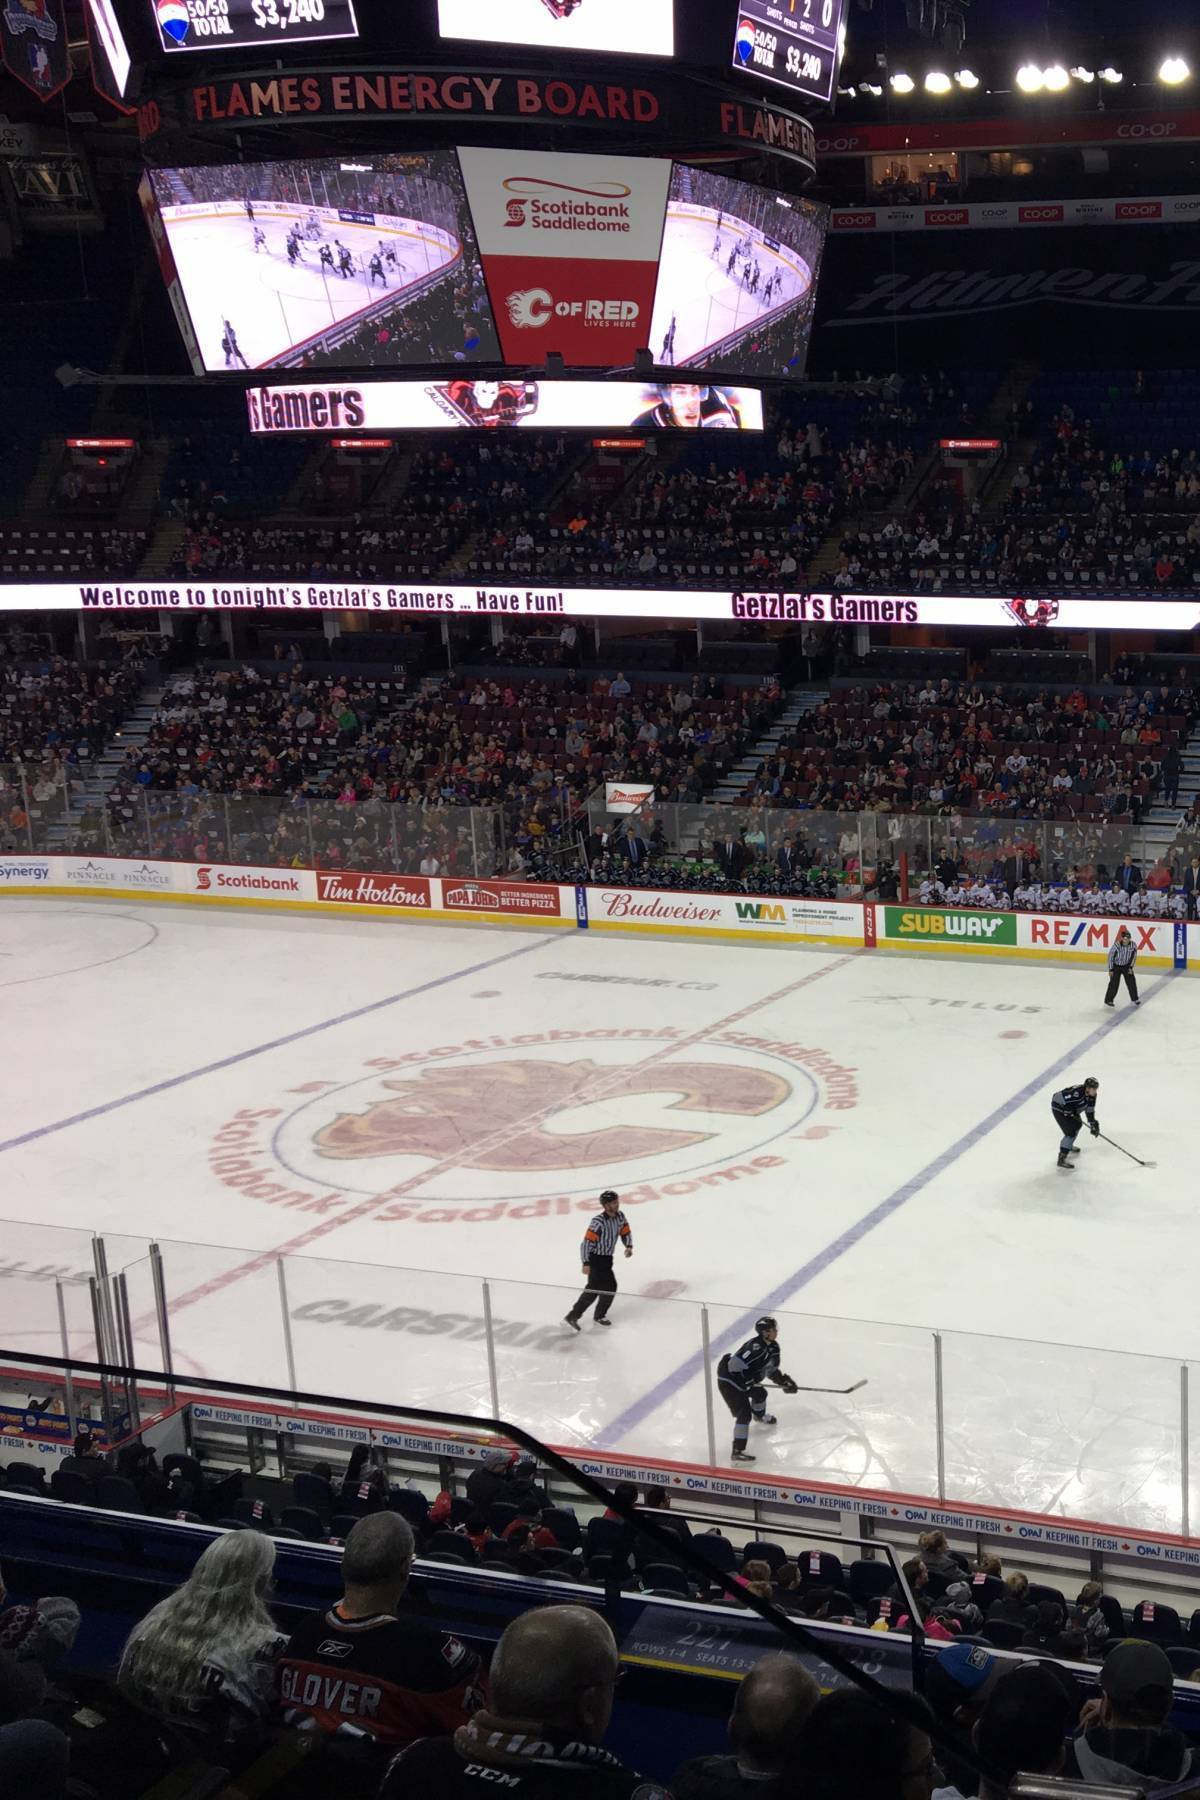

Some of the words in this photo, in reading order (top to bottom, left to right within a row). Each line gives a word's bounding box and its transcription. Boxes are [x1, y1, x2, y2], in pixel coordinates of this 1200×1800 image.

[190, 15, 234, 37] TOTAL
[753, 45, 775, 69] TOTAL
[754, 29, 778, 51] 50/50
[785, 45, 822, 81] $3,240
[192, 77, 321, 121] FLAMES
[331, 74, 503, 112] ENERGY
[516, 79, 660, 123] BOARD
[720, 102, 800, 151] FLAMES
[531, 199, 630, 218] Scotiabank
[531, 215, 631, 233] Saddledome
[555, 301, 583, 317] OF
[585, 300, 640, 321] RED
[260, 387, 366, 429] Gamers
[80, 587, 180, 606] Welcome
[186, 588, 206, 606] to
[213, 587, 302, 608] tonight's
[307, 587, 382, 608] Getzlaf's
[387, 589, 454, 609] Gamers
[477, 591, 520, 611] Have
[526, 592, 565, 612] Fun!
[731, 592, 824, 620] Getzlaf's
[830, 596, 918, 622] Gamers
[66, 871, 117, 881] PINNACLE
[123, 874, 169, 884] PINNACLE
[217, 873, 300, 891] Scotiabank
[320, 876, 354, 900] Tim
[356, 877, 427, 905] Hortons
[501, 898, 531, 907] BETTER
[532, 900, 557, 909] PIZZA.
[601, 893, 722, 922] Budweiser
[735, 902, 787, 921] WM
[898, 913, 1005, 938] SUBWAY
[928, 998, 1048, 1014] TELUS
[363, 1026, 694, 1068] Scotiabank
[716, 1028, 863, 1112] Saddledome
[207, 1107, 349, 1215] Scotiabank
[194, 1407, 213, 1419] OPA!
[216, 1409, 243, 1424] KEEPING
[243, 1414, 250, 1425] IT
[252, 1415, 272, 1428] FRESH
[382, 1434, 402, 1446] OPA!
[404, 1436, 433, 1451] KEEPING
[434, 1441, 442, 1452] IT
[443, 1443, 465, 1456] FRESH
[794, 1493, 816, 1504] OPA!
[819, 1496, 851, 1511] KEEPING
[854, 1501, 861, 1512] IT
[862, 1502, 887, 1516] FRESH
[1137, 1544, 1161, 1558] OPA!
[1164, 1548, 1200, 1564] KEEPING
[676, 1621, 742, 1652] 227
[631, 1641, 665, 1657] ROWS
[668, 1646, 687, 1659] 1-4
[695, 1652, 729, 1666] SEATS
[281, 1668, 382, 1717] GLOVER
[463, 1763, 522, 1789] CCM
